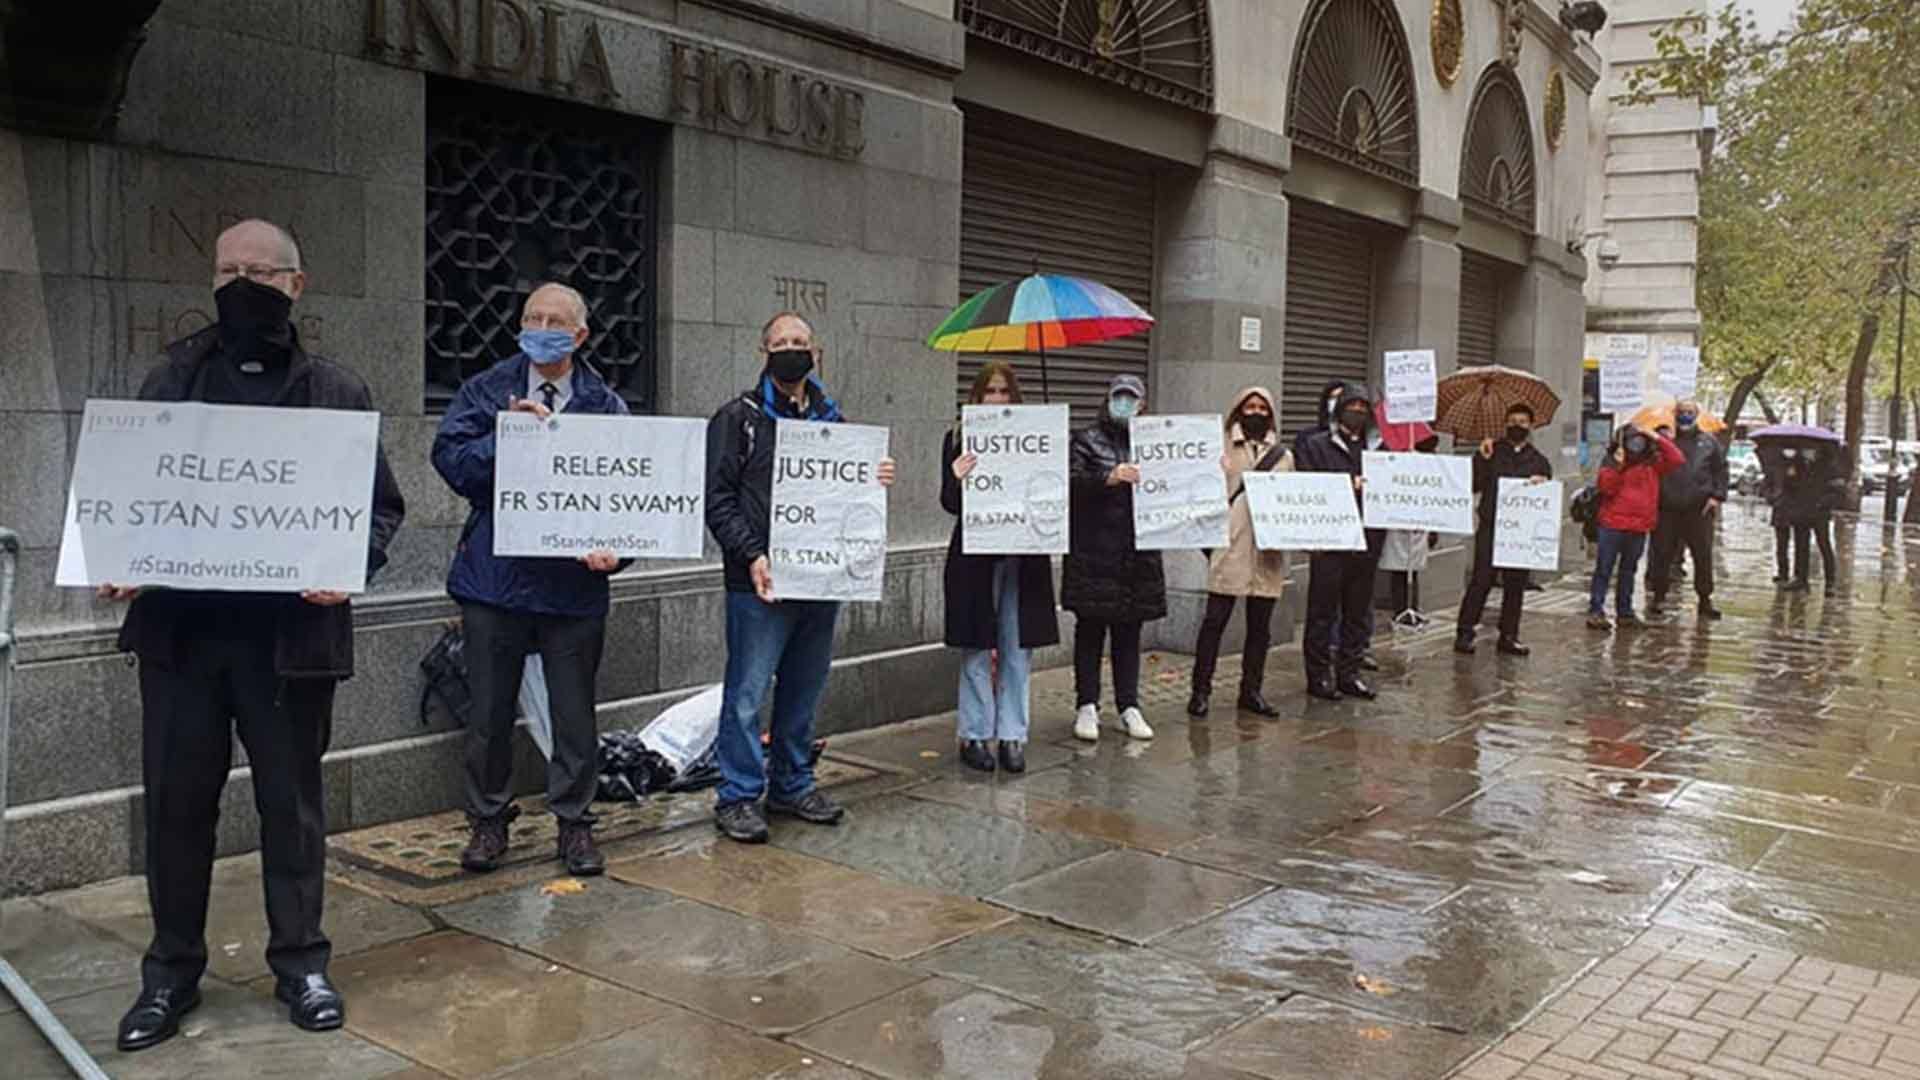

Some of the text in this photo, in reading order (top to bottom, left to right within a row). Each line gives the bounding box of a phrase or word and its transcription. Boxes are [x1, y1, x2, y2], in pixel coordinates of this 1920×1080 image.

[365, 0, 866, 157] INDIA HOUSE
[967, 434, 1050, 454] JUSTICE
[1135, 441, 1208, 464] JUSTICE
[156, 453, 298, 485] RELEASE
[553, 456, 653, 478] RELEASE
[776, 456, 869, 484] JUSTICE
[966, 475, 1003, 491] FOR
[1391, 474, 1442, 488] RELEASE
[500, 490, 700, 515] FR STAN SWAMY
[75, 499, 363, 532] FR STAN SWAMY
[774, 504, 817, 525] FOR
[986, 513, 1026, 525] STAN
[128, 554, 300, 580] #StandwithStan
[800, 549, 840, 565] STAN
